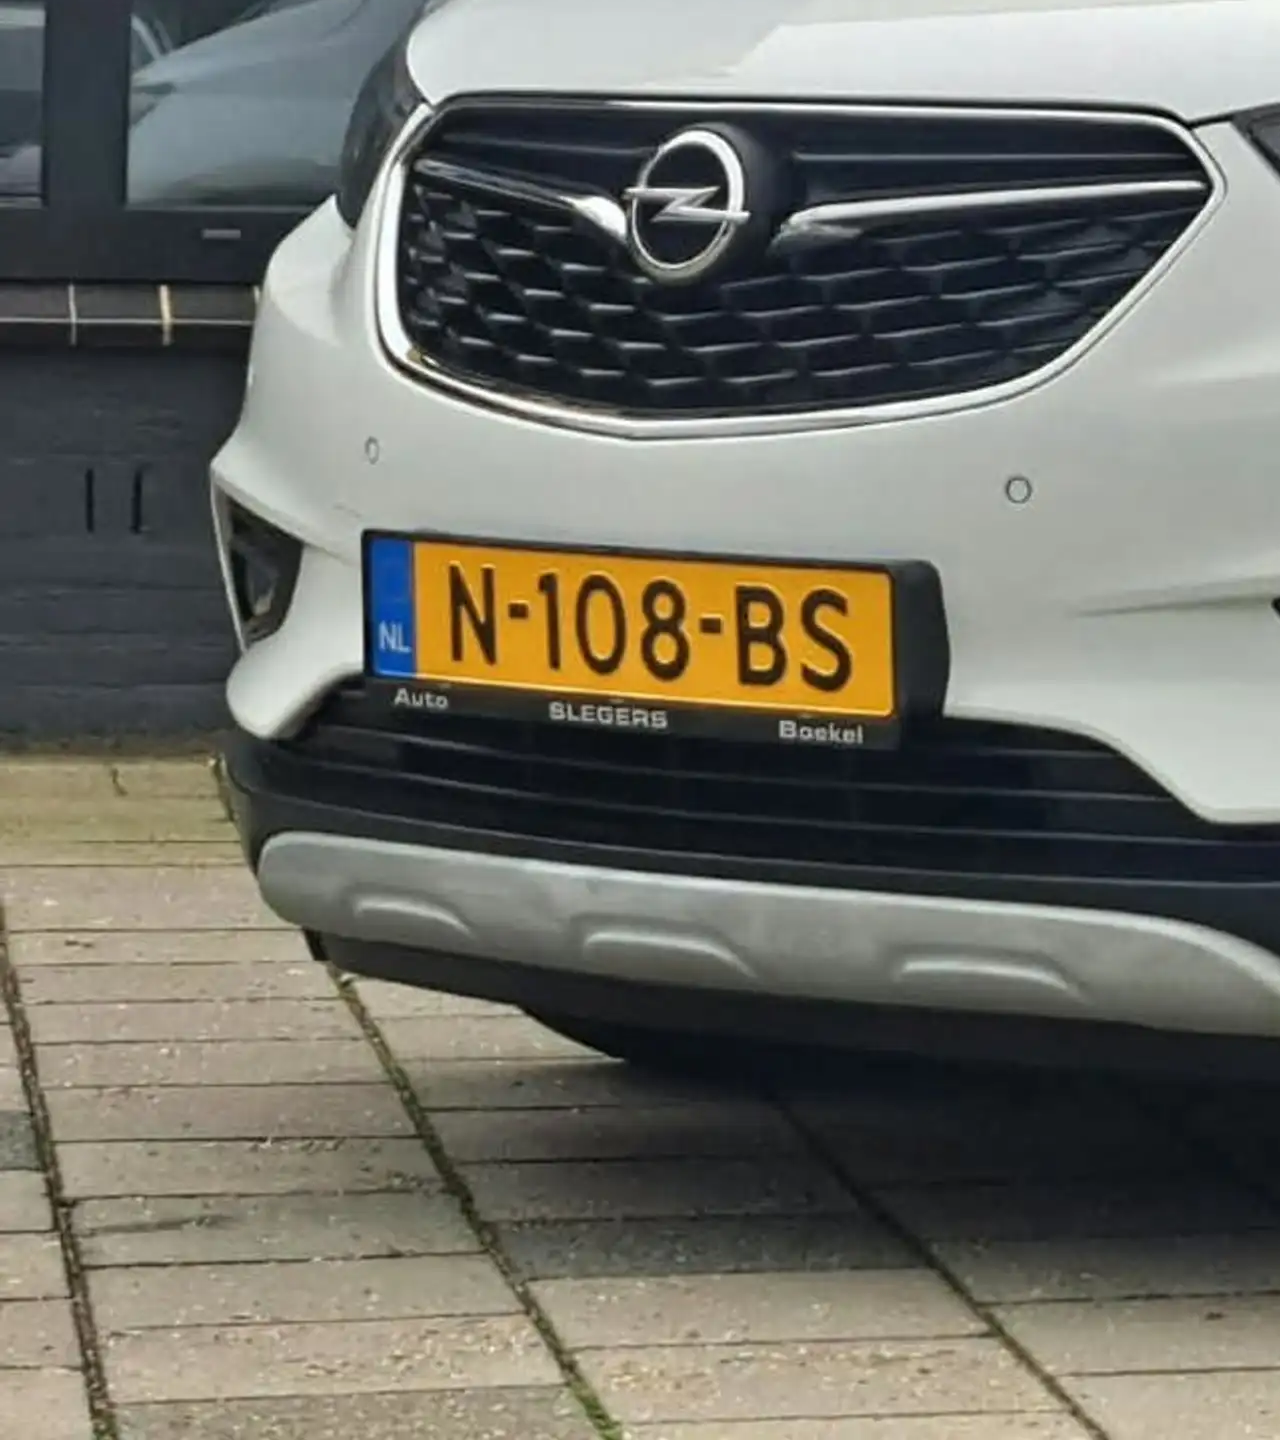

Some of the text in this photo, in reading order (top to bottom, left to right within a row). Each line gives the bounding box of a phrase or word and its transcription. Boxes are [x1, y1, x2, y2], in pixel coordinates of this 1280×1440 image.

[379, 621, 412, 654] NL
[448, 560, 853, 694] N-108-BS
[394, 687, 864, 746] Auto SLEGERS Boekel
